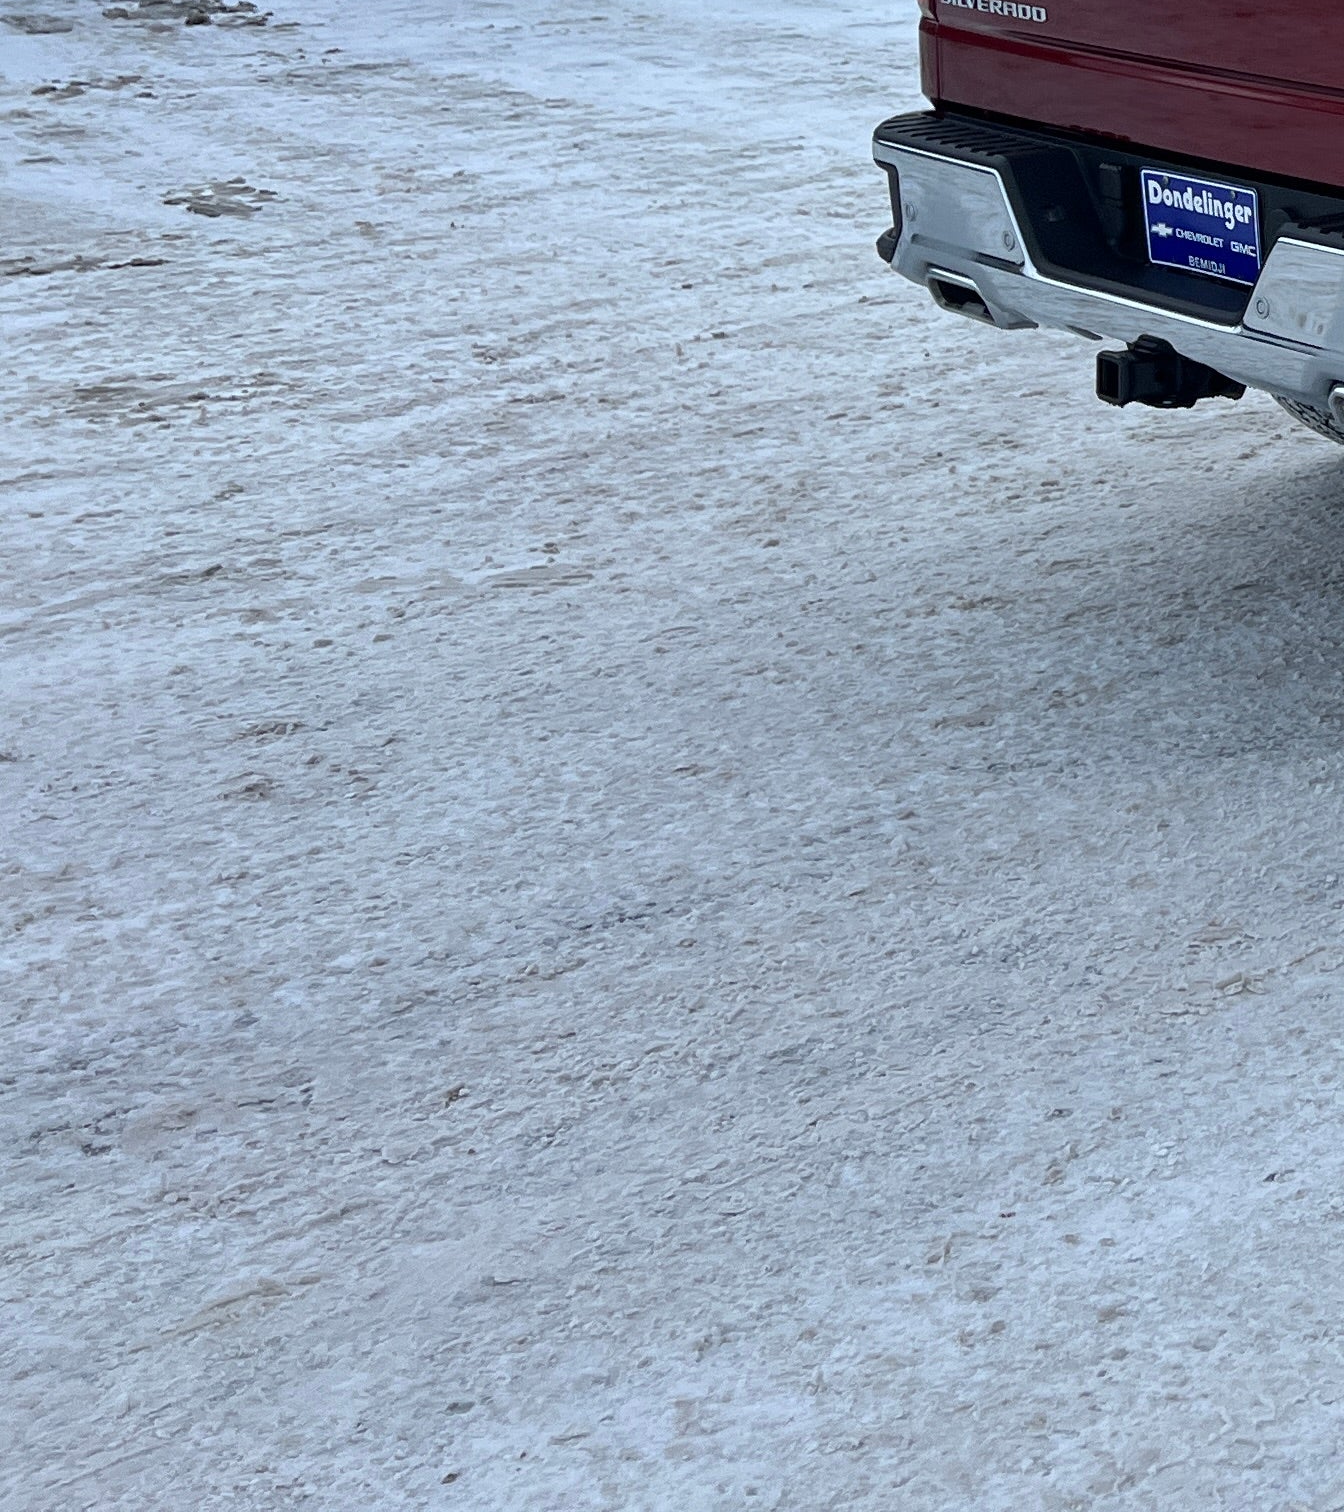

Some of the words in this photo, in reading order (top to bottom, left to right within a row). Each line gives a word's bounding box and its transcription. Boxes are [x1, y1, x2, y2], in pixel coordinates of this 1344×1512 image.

[1147, 179, 1252, 230] Dondelinger
[1175, 228, 1225, 248] CHEVROLET
[1230, 241, 1257, 257] GMC
[1188, 255, 1227, 275] BEMIDJI
